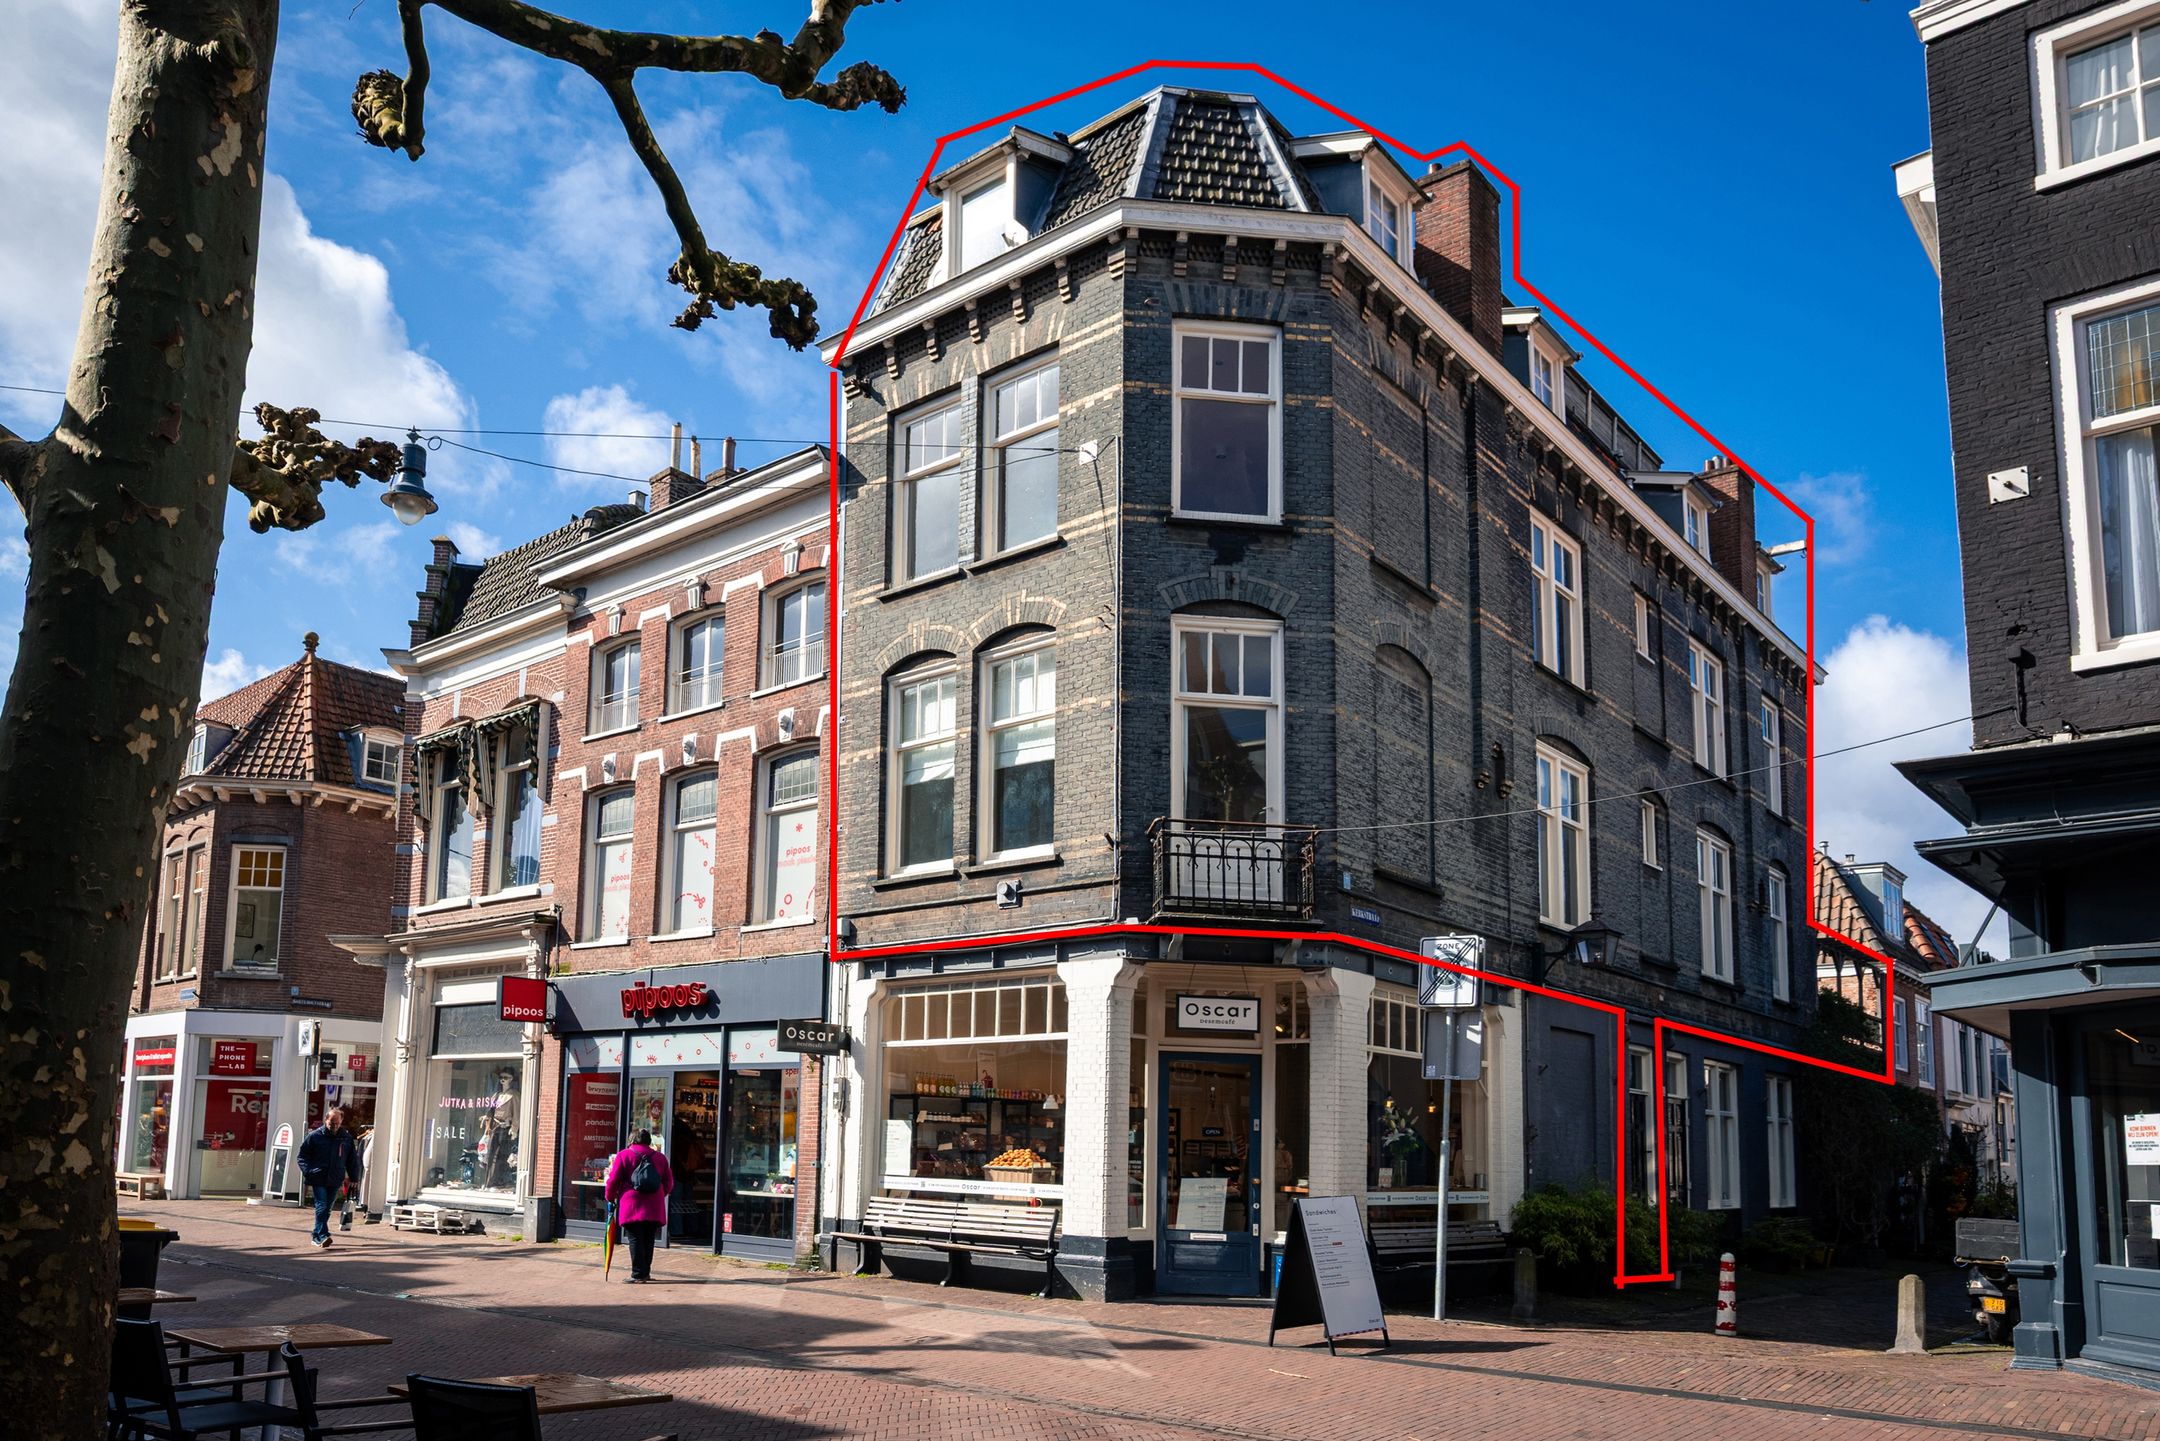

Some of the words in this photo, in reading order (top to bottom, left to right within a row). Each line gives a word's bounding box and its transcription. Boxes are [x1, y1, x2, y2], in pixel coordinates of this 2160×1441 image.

[786, 846, 810, 857] pipoos
[1437, 942, 1460, 950] ZONE
[621, 981, 706, 1018] pipoos
[503, 1004, 544, 1018] pipoos
[1186, 1003, 1251, 1018] Oscar
[786, 1027, 835, 1042] Oscar
[439, 1096, 466, 1109] JUTKA
[467, 1098, 474, 1109] &
[585, 1119, 615, 1127] panduro
[436, 1126, 466, 1140] SALE
[1304, 1209, 1337, 1217] Sandwiches
